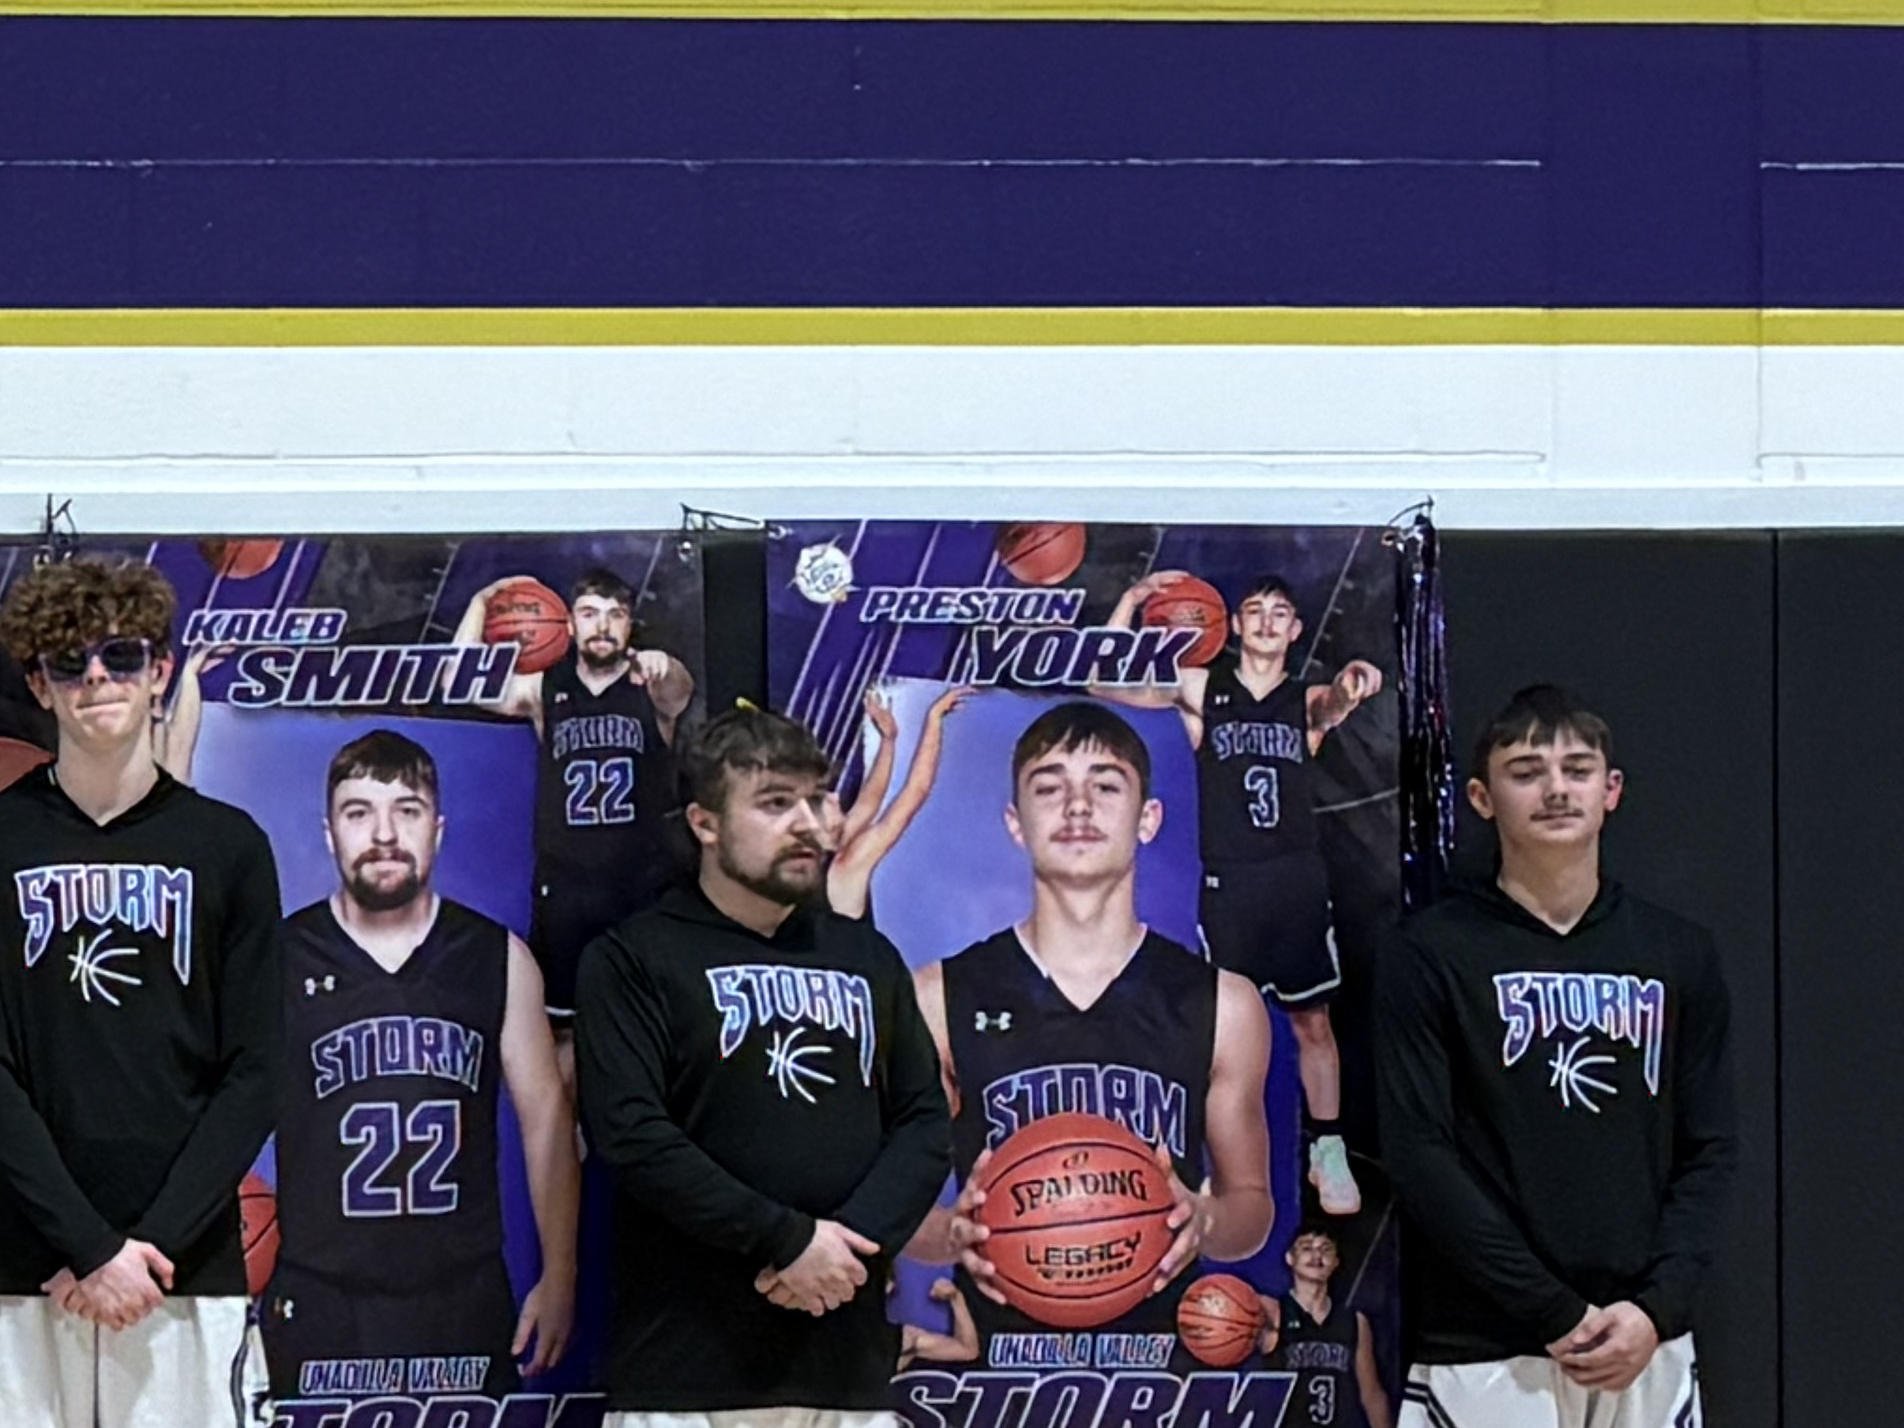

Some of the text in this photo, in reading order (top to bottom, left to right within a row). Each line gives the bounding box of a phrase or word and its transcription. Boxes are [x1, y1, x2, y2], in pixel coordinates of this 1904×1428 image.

[183, 609, 347, 646] KALEB
[859, 587, 1087, 625] PRESTON
[228, 642, 522, 709] SMITH
[968, 626, 1201, 687] YORK
[564, 757, 636, 826] 22
[1244, 766, 1280, 828] 3
[13, 863, 194, 987] STORM
[311, 1015, 486, 1099] STORM
[705, 965, 876, 1087] STORM
[1493, 971, 1667, 1096] STORM
[340, 1100, 462, 1218] 22
[1009, 1168, 1149, 1218] SPALDING
[1025, 1231, 1142, 1266] LEGACY
[1309, 1375, 1335, 1425] 3
